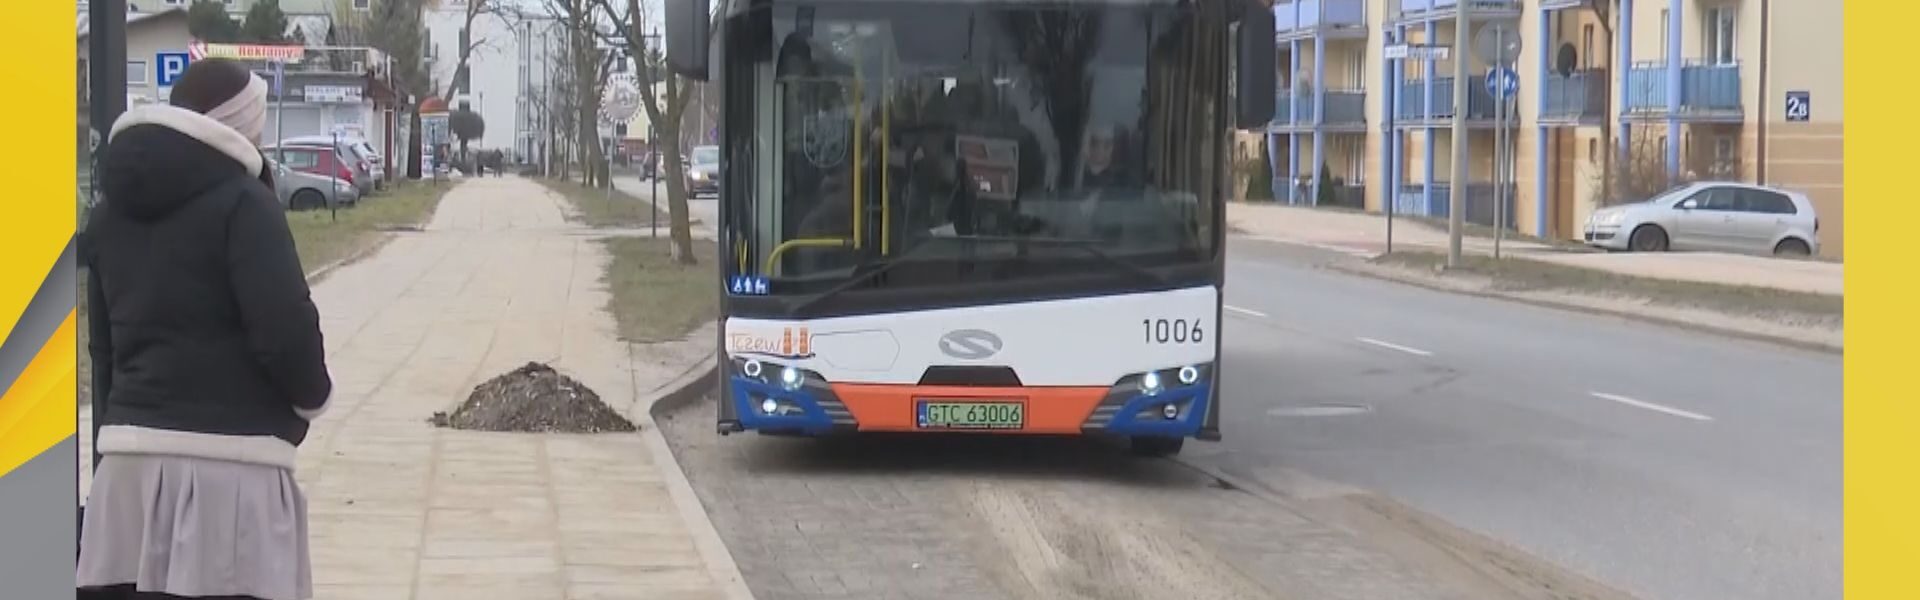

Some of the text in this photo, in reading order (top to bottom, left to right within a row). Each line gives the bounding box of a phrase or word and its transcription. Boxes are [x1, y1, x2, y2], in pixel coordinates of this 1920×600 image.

[164, 55, 183, 82] P
[1143, 318, 1203, 343] 1006
[928, 405, 960, 422] GTC
[967, 405, 1020, 422] 63006
